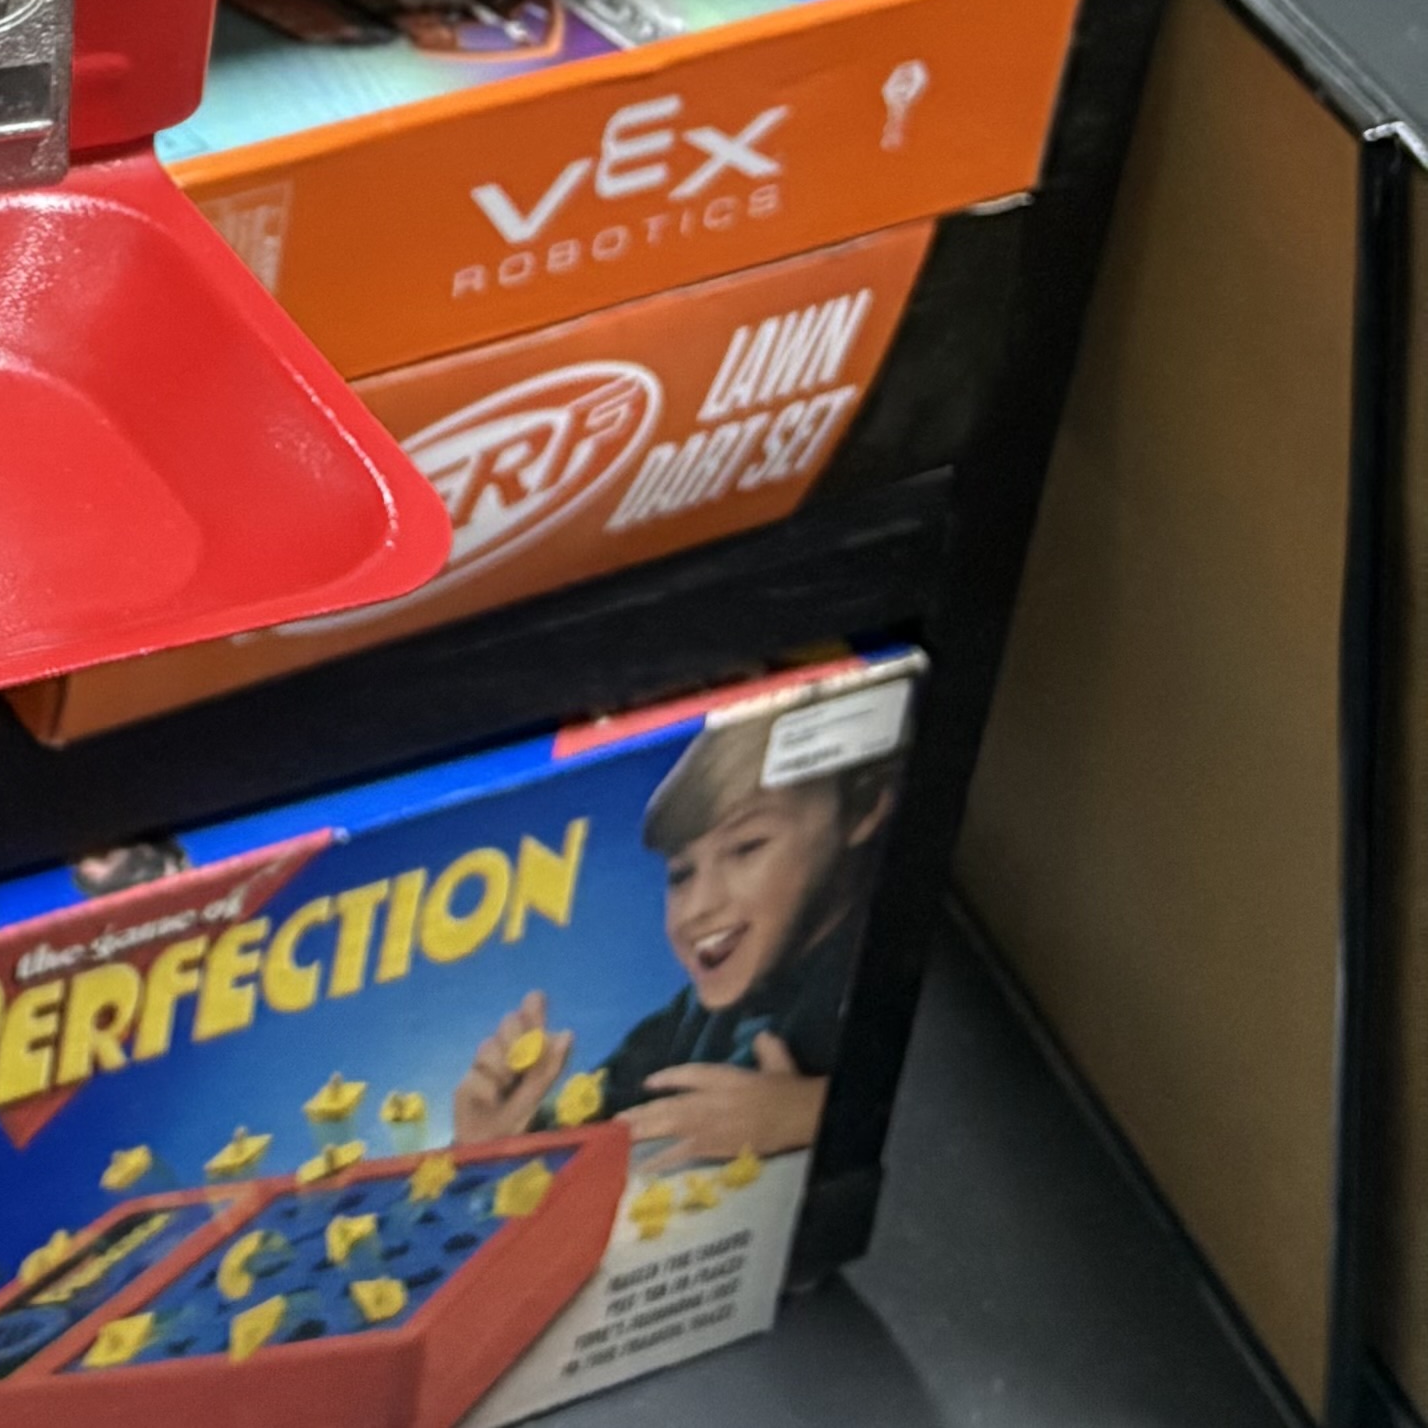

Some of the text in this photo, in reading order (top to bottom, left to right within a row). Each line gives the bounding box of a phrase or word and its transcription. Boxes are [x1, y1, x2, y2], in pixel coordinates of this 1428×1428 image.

[452, 183, 782, 299] ROBOTICS
[470, 93, 791, 245] VEX
[696, 286, 875, 423] LAWN
[602, 383, 860, 535] DART SET
